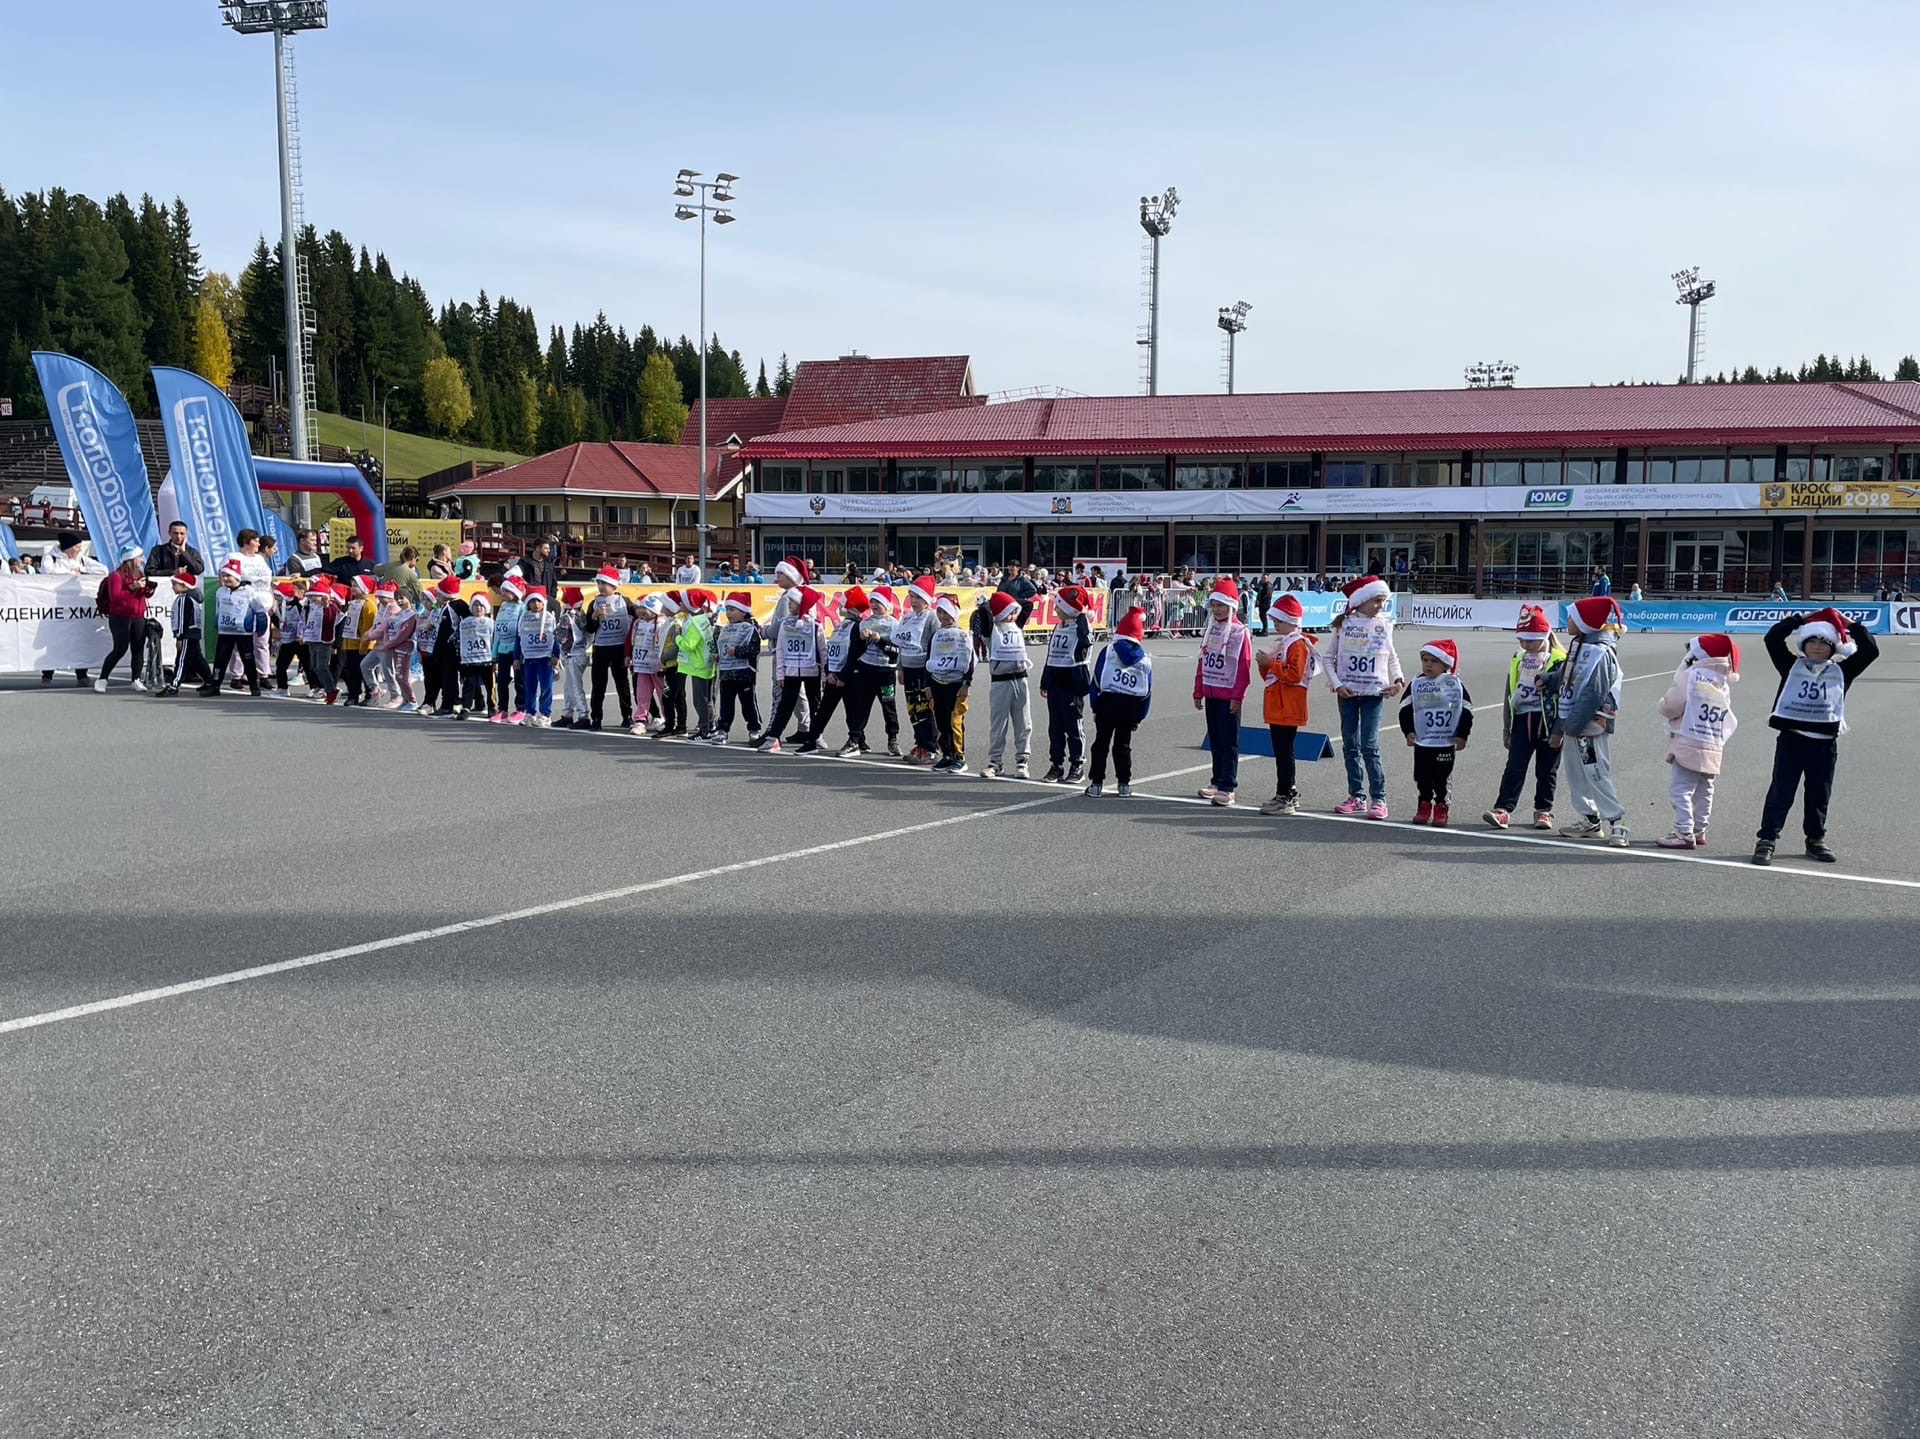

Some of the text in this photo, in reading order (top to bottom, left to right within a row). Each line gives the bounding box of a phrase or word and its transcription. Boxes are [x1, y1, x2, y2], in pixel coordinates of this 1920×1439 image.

[1791, 483, 1831, 494] КРОСС
[1530, 491, 1568, 502] ЮМС
[1791, 493, 1890, 508] НАЦИИ 2022
[1627, 610, 1679, 622] выбирает
[1681, 611, 1718, 623] спорт!
[601, 619, 621, 631] 362
[467, 639, 486, 651] 349
[787, 639, 806, 652] 381
[634, 648, 648, 661] 357
[1204, 652, 1226, 670] 365
[937, 656, 959, 669] 371
[1349, 655, 1376, 673] 361
[1112, 668, 1138, 689] 369
[1798, 680, 1828, 700] 351
[1425, 711, 1453, 728] 352
